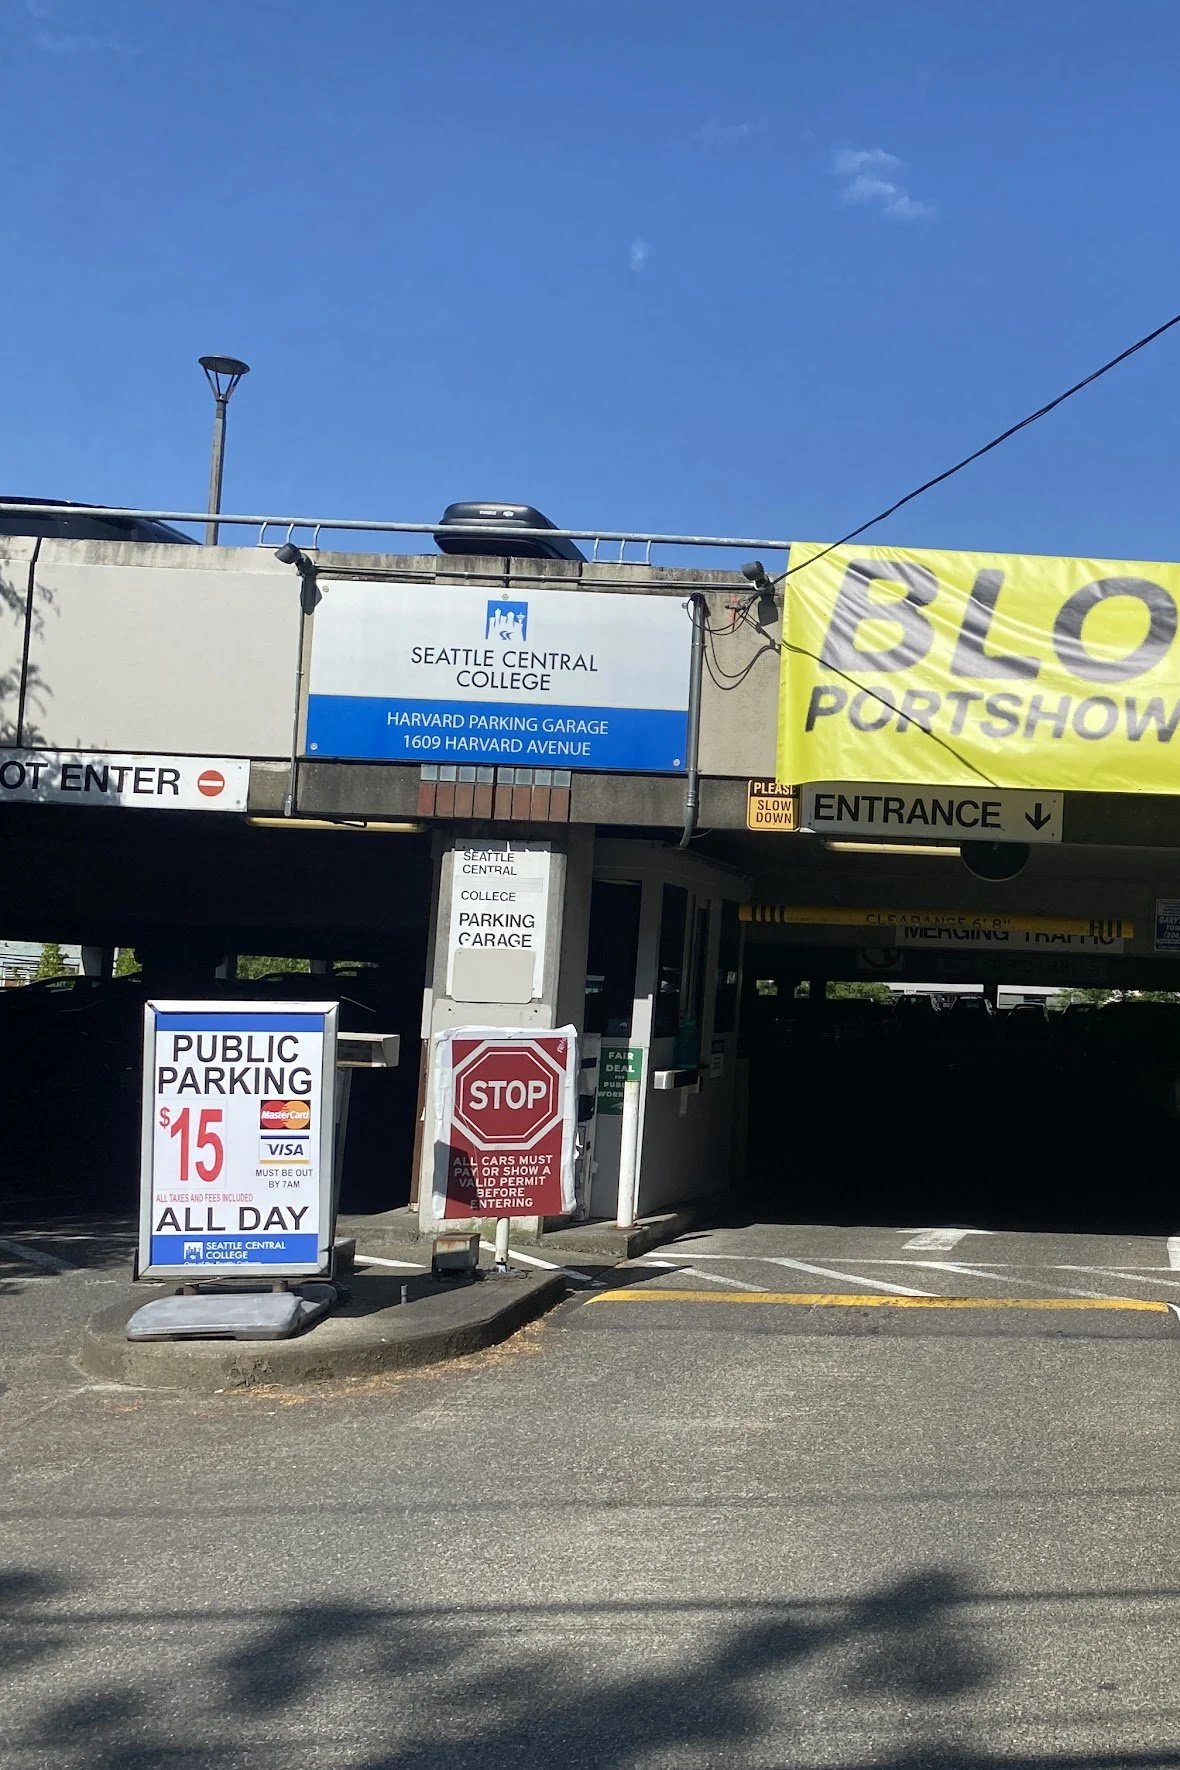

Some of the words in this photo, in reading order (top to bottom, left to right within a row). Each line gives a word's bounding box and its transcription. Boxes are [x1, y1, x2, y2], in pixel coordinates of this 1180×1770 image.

[411, 646, 494, 667] SEATTLE
[502, 650, 598, 672] CENTRAL
[456, 670, 550, 691] COLLEGE
[387, 711, 465, 729] HARVARD
[468, 716, 538, 732] PARKING
[541, 719, 609, 735] GARAGE
[403, 734, 441, 750] 1609
[444, 736, 523, 753] HARVARD
[526, 740, 591, 756] AVENUE
[0, 760, 48, 790] OT
[60, 763, 181, 796] ENTER
[757, 799, 791, 811] SLOW
[813, 793, 1003, 828] ENTRANCE
[756, 812, 792, 824] DOWN
[463, 852, 515, 862] SEATTLE
[462, 864, 518, 876] CENTRAL
[460, 890, 517, 902] COLLEGE
[459, 912, 536, 929] PARKING
[458, 932, 533, 948] GARAGE
[173, 1034, 299, 1063] PUBLIC
[608, 1051, 634, 1060] FAIR
[605, 1064, 635, 1073] DEAL
[158, 1066, 312, 1095] PARKING
[469, 1080, 547, 1111] STOP
[261, 1110, 309, 1120] MasterCard
[159, 1106, 224, 1183] $15
[267, 1144, 304, 1156] VISA
[453, 1157, 478, 1166] ALL
[481, 1156, 515, 1165] CARS
[519, 1155, 553, 1165] MUST
[255, 1169, 279, 1177] MUST
[282, 1169, 293, 1177] BE
[296, 1169, 313, 1177] OUT
[454, 1167, 478, 1177] PAY
[481, 1168, 499, 1176] OR
[503, 1166, 539, 1176] SHOW
[542, 1166, 551, 1175] A
[459, 1178, 496, 1188] VALID
[500, 1176, 546, 1187] PERMIT
[156, 1194, 167, 1203] ALL
[169, 1194, 189, 1203] TAXES
[190, 1194, 203, 1203] AND
[204, 1194, 220, 1202] FEES
[222, 1194, 254, 1203] INCLUDED
[476, 1187, 525, 1198] BEFORE
[470, 1199, 534, 1210] ENTERING
[156, 1207, 226, 1232] ALL
[238, 1206, 309, 1231] DAY
[206, 1241, 243, 1250] SEATTLE
[245, 1241, 286, 1250] CENTRAL
[205, 1251, 249, 1260] COLLEGE
